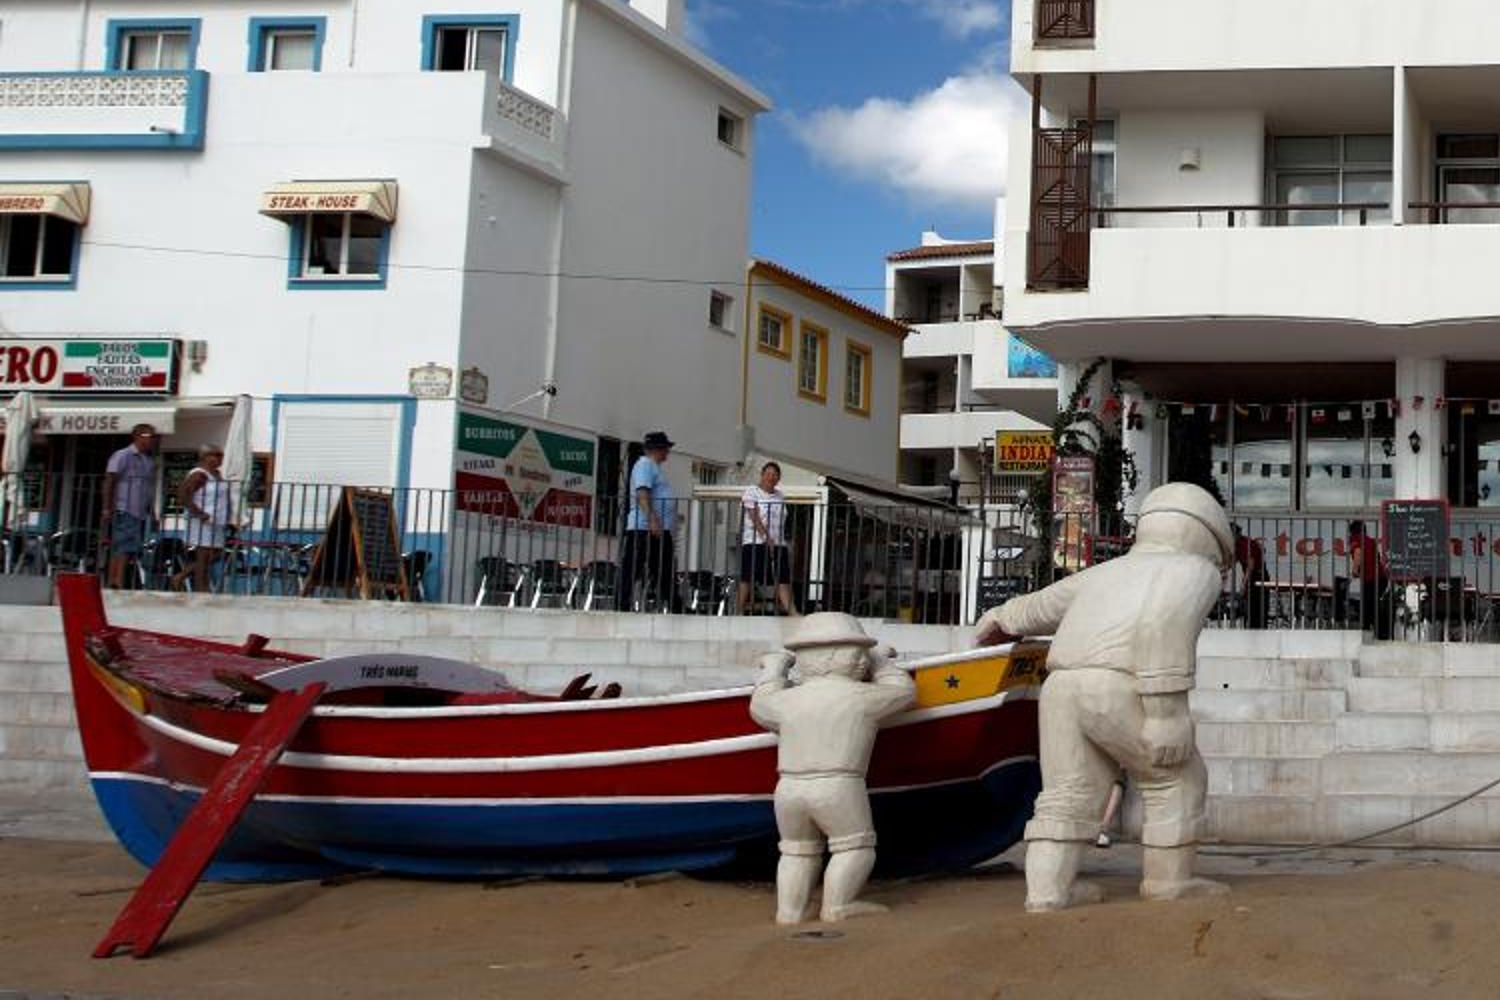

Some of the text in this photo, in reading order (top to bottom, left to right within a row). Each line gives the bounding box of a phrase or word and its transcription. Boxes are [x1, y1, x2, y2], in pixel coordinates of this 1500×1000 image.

[269, 196, 309, 208] STEAK
[316, 195, 358, 208] HOUSE
[0, 346, 58, 384] RO
[63, 415, 120, 430] HOUSE
[464, 427, 516, 441] BURRITOS
